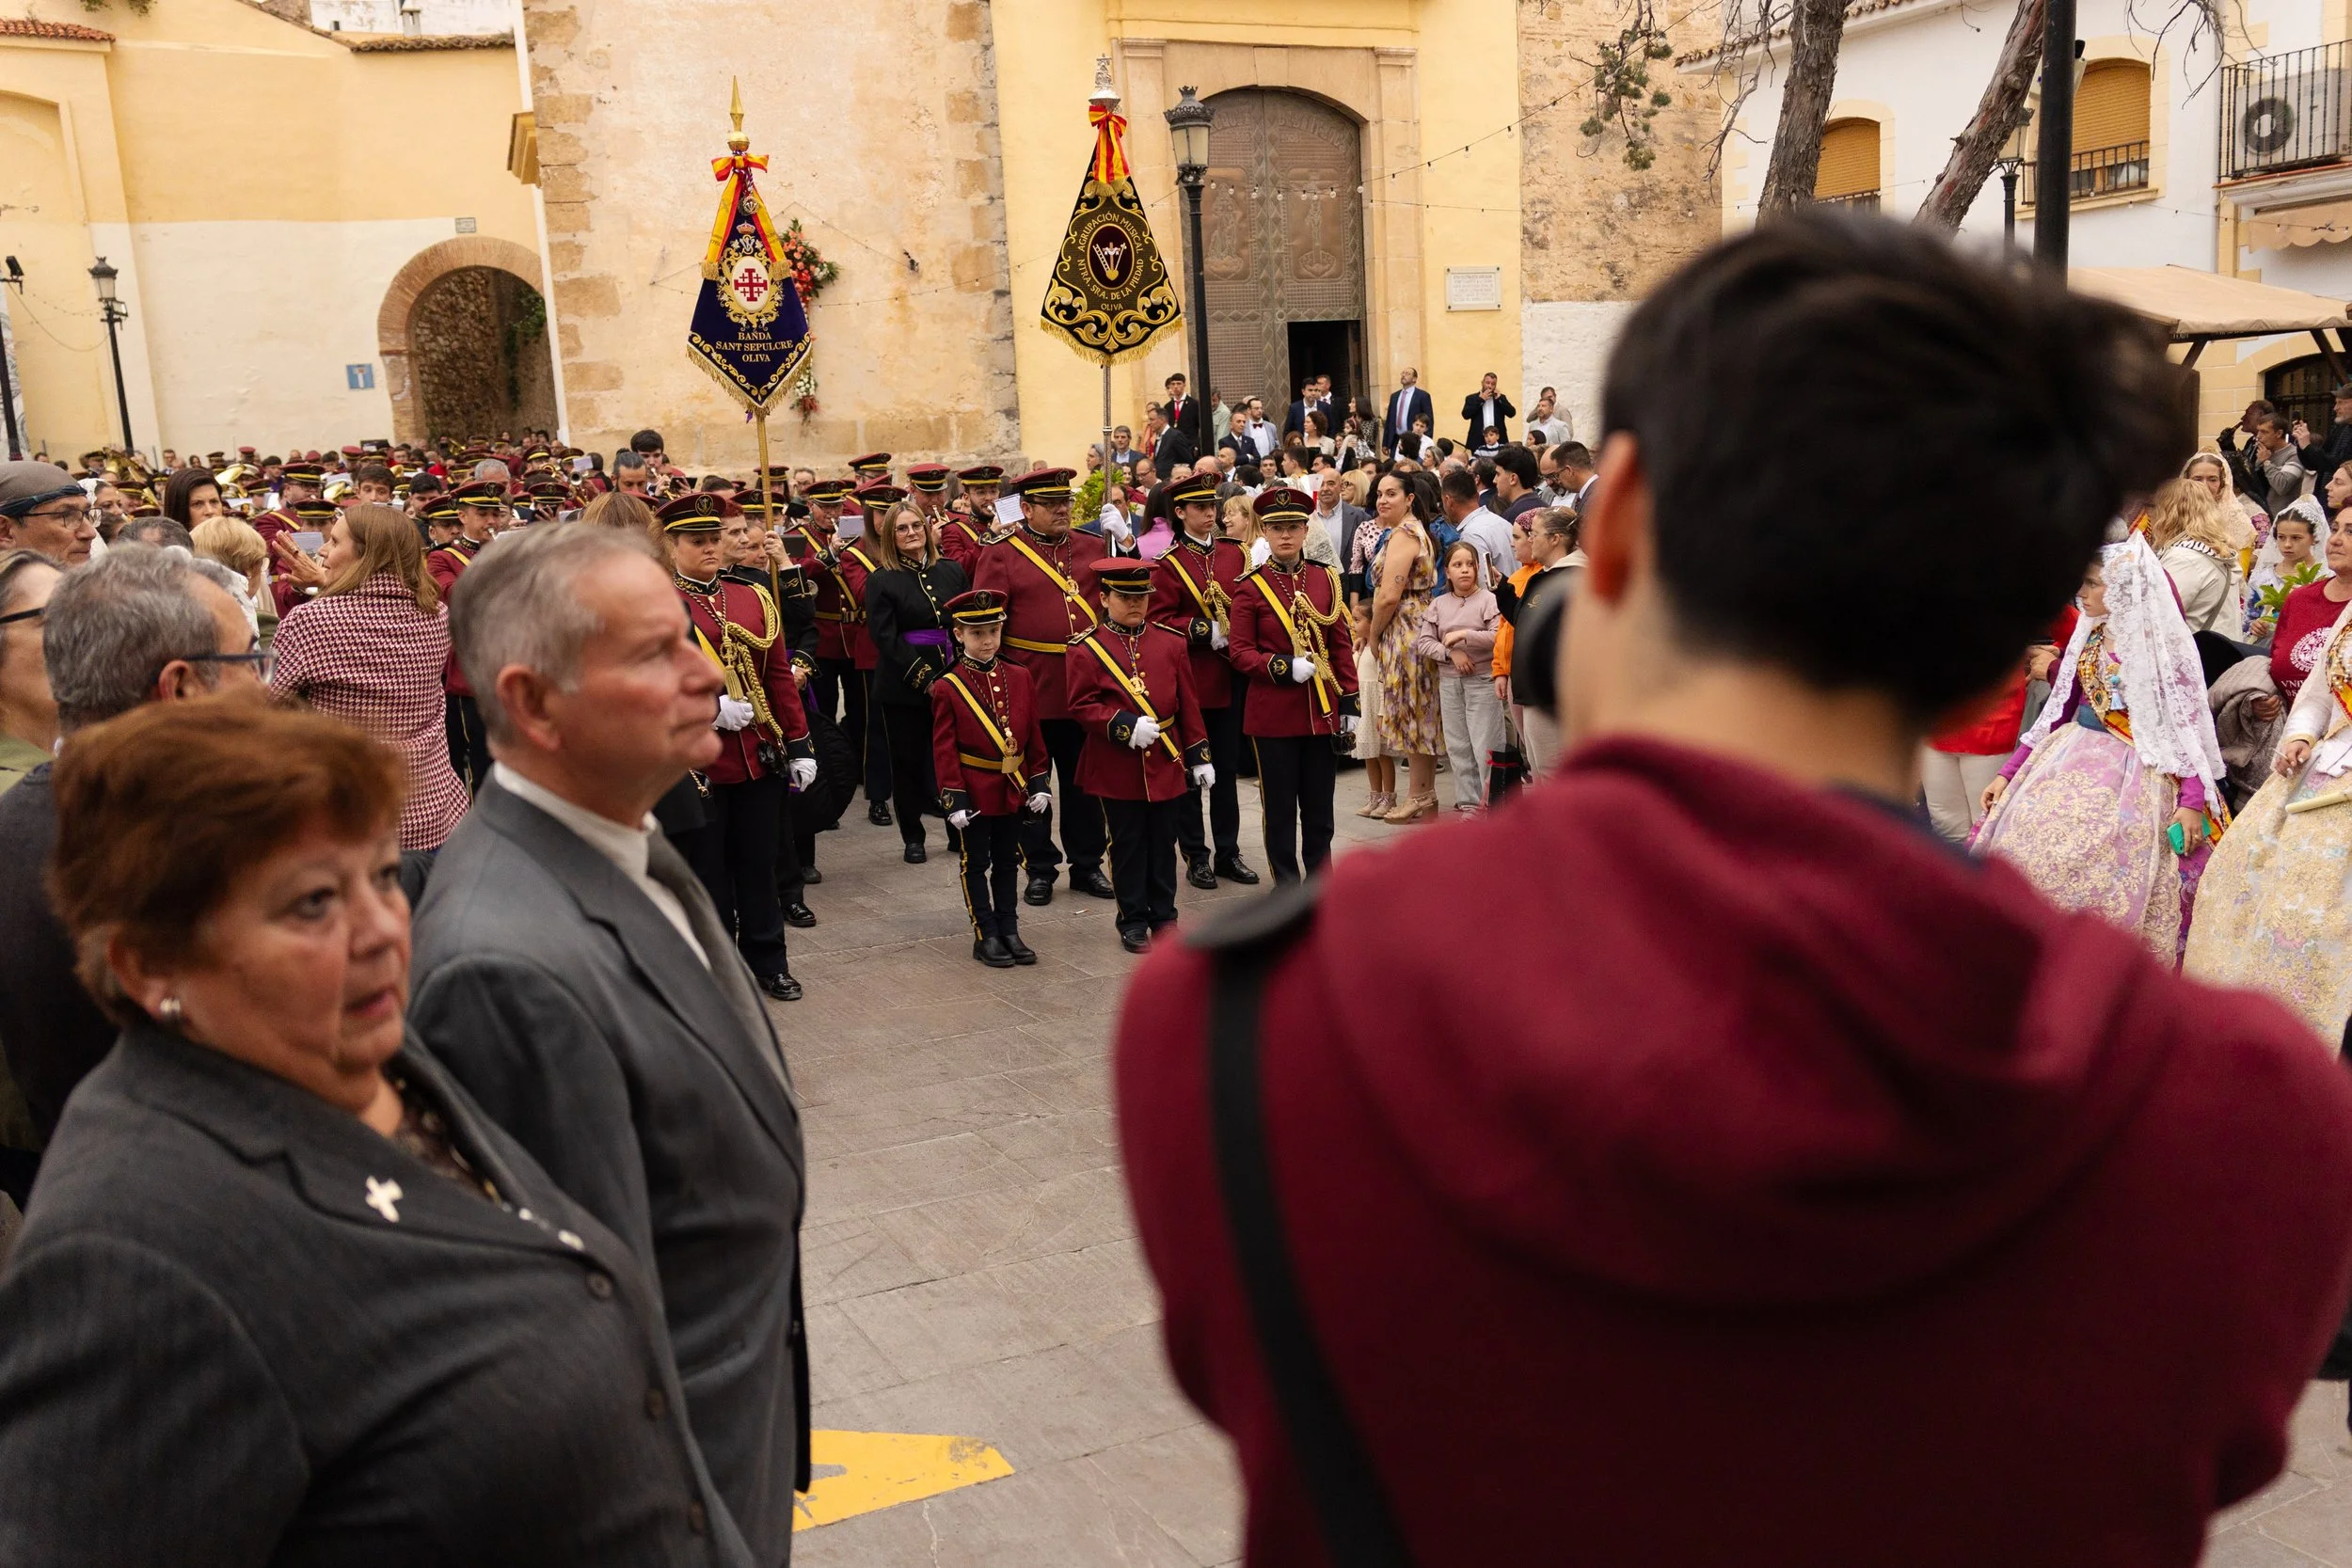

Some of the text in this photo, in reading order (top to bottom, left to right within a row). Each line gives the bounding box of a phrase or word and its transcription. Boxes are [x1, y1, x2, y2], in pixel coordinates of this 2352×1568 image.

[1077, 211, 1144, 254] AGRUPACIÓN MUSICAL
[1077, 259, 1091, 287] NTRA.
[1090, 284, 1108, 300] SRA.
[1120, 286, 1133, 297] LA
[1129, 259, 1144, 289] PIEDAD
[715, 340, 794, 352] SANT SEPULCRE
